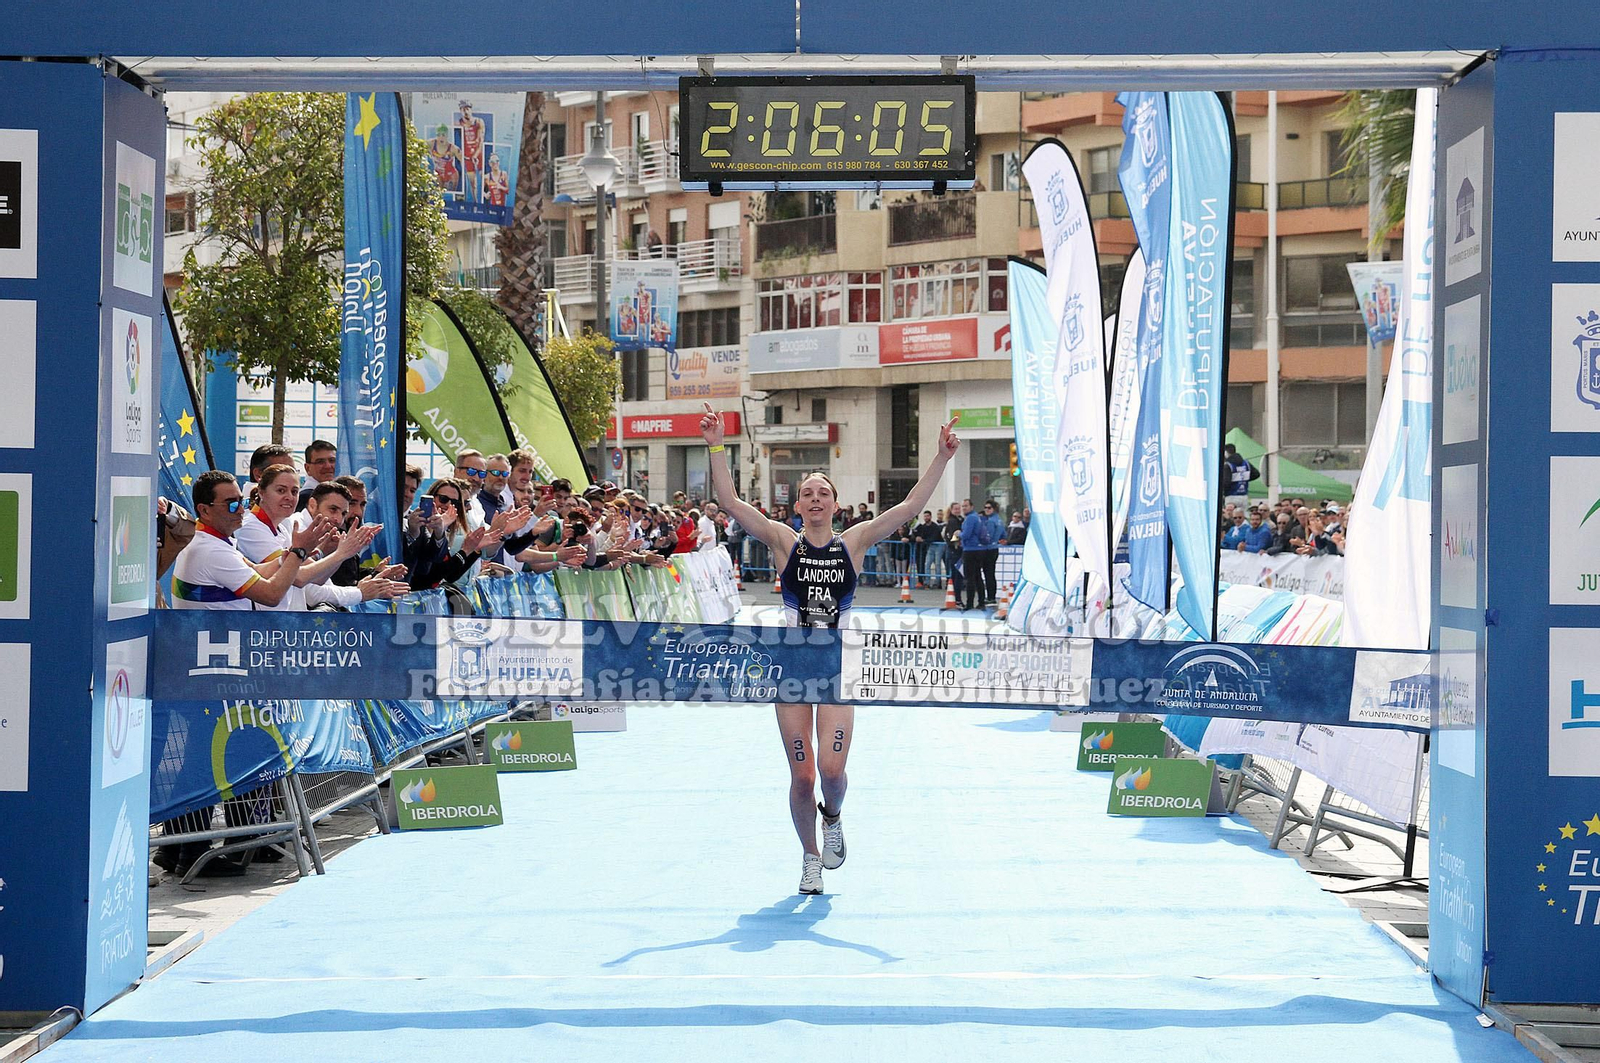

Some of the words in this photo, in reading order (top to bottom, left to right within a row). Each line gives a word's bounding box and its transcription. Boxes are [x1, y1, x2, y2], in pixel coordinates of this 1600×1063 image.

[700, 101, 954, 157] 2:06:05
[826, 161, 846, 170] 615
[846, 161, 863, 170] 980
[864, 161, 882, 170] 784
[894, 161, 912, 170] 630
[913, 161, 930, 170] 367
[931, 160, 949, 169] 452
[711, 350, 741, 363] VENDE
[637, 418, 673, 433] MAPFRE
[797, 566, 845, 583] LANDRON
[807, 585, 833, 602] FRA
[250, 627, 373, 647] DIPUTACIÓN
[861, 633, 949, 650] TRIATHLON
[663, 639, 751, 658] European
[250, 651, 275, 667] DE
[282, 651, 362, 667] HUELVA
[498, 656, 561, 666] Ayuntamiento
[562, 656, 574, 664] de
[861, 650, 947, 668] EUROPEAN
[951, 652, 984, 669] CUP
[497, 667, 574, 682] HUELVA
[663, 656, 783, 680] Triathlon
[861, 667, 917, 685] HUELVA
[920, 670, 956, 686] 2019
[729, 683, 778, 698] Union
[860, 688, 876, 698] ETU
[1162, 688, 1191, 698] JUNTA
[1195, 690, 1206, 699] DE
[1210, 690, 1258, 702] ANDALUCIA
[1193, 701, 1202, 709] DE
[1203, 702, 1229, 710] TURISMO
[1235, 704, 1263, 712] DEPORTE
[1358, 709, 1419, 722] AYUNTAMIENTO
[501, 752, 573, 764] IBERDROLA
[1120, 794, 1203, 810] IBERDROLA
[411, 804, 499, 821] IBERDROLA
[1438, 843, 1466, 882] European
[1438, 878, 1475, 932] Triathlon
[1455, 936, 1472, 964] Union
